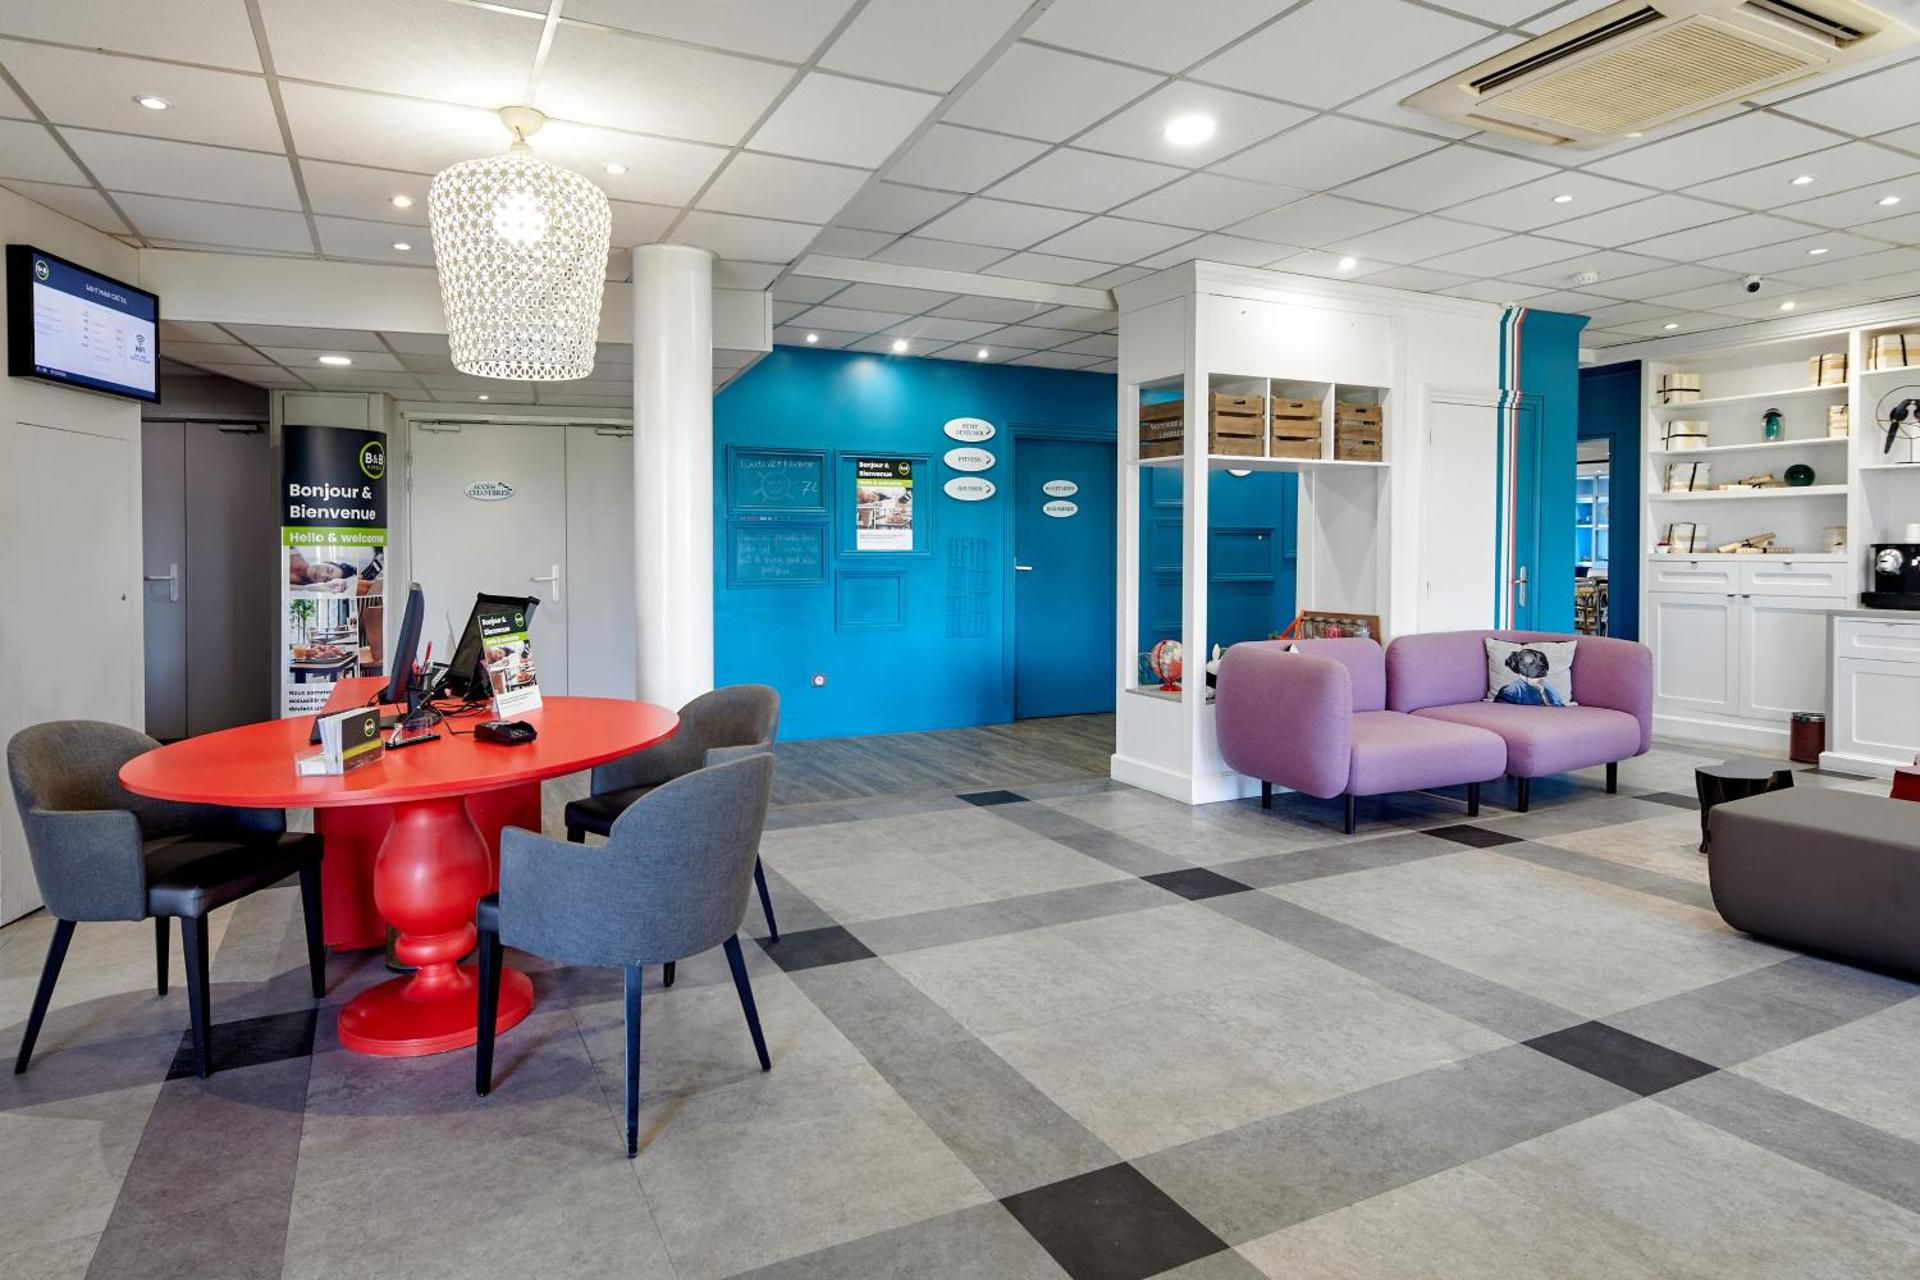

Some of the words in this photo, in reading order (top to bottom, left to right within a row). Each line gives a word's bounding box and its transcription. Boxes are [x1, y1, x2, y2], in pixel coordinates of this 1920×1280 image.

[365, 452, 384, 465] B&B
[289, 482, 359, 501] Bonjour
[361, 486, 372, 499] &
[289, 503, 376, 520] Bienvenue
[289, 532, 324, 543] Hello
[328, 532, 337, 543] &
[341, 533, 384, 544] welcome
